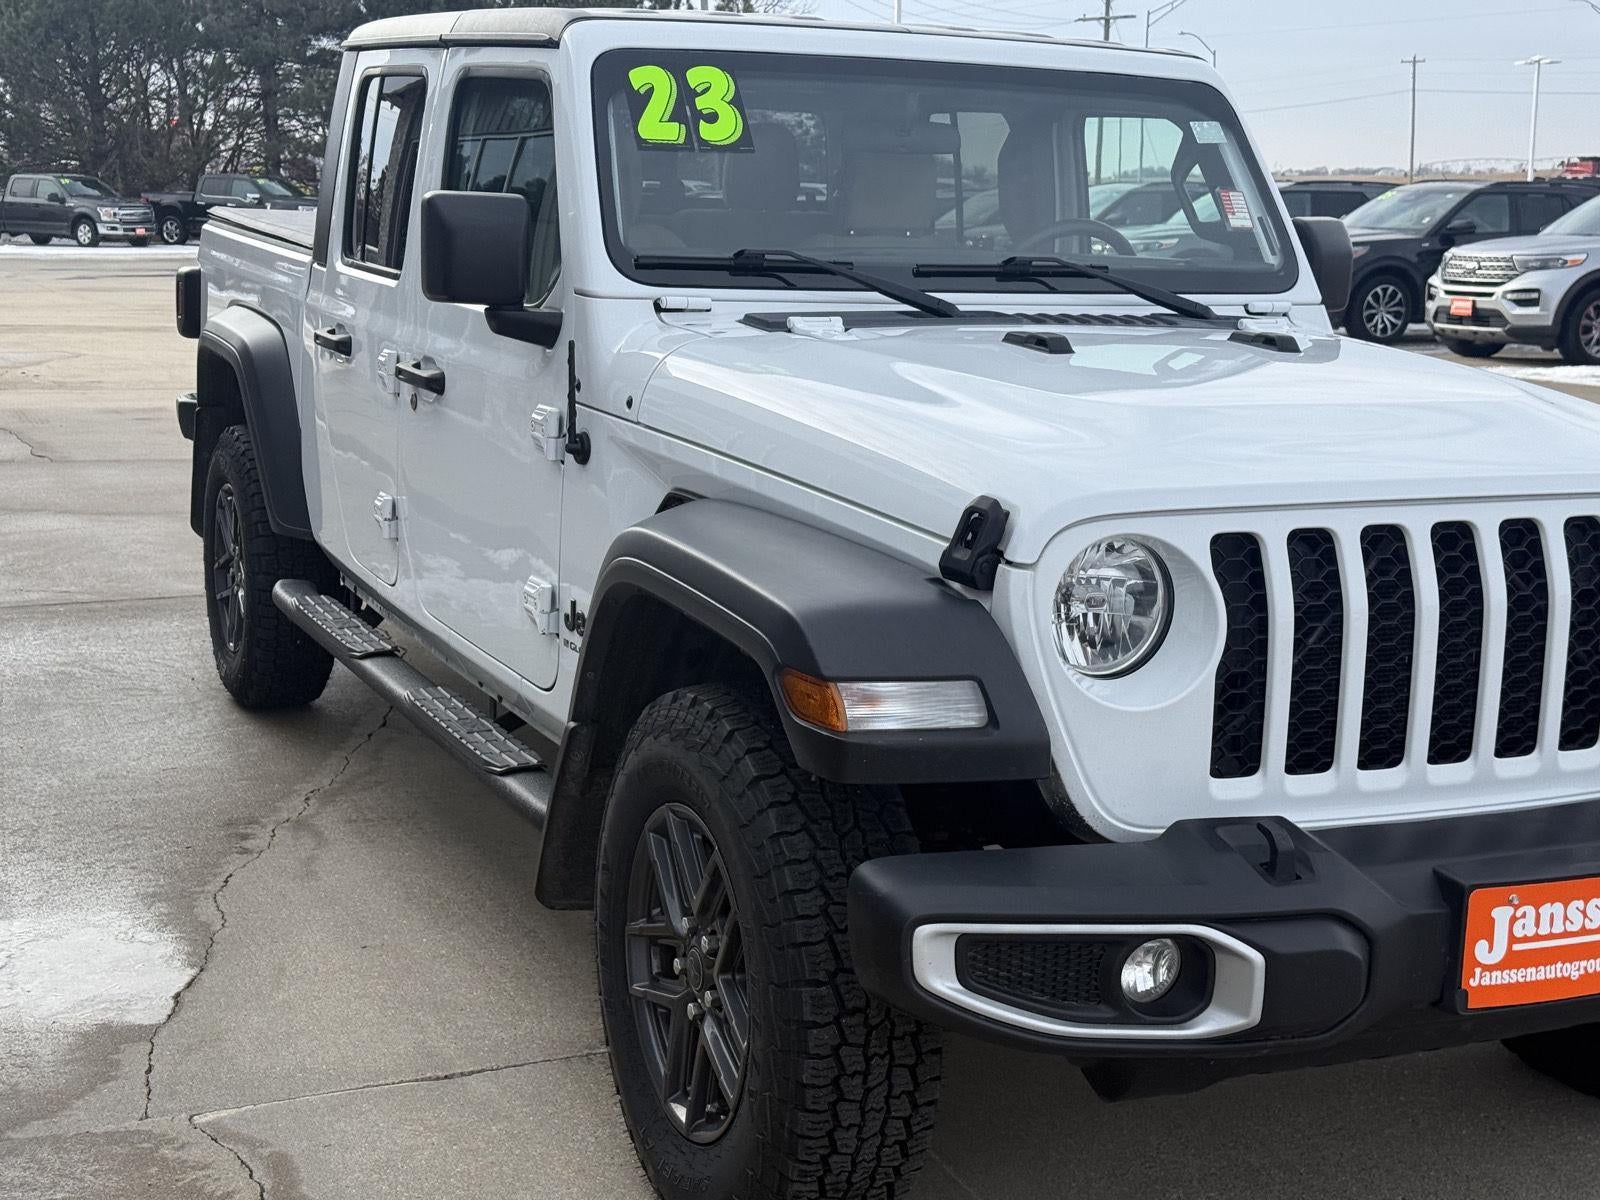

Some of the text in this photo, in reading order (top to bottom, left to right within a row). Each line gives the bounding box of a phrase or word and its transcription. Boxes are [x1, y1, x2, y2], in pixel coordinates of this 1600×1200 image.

[628, 65, 744, 145] 23
[564, 599, 586, 637] Je
[1474, 898, 1600, 965] Janss
